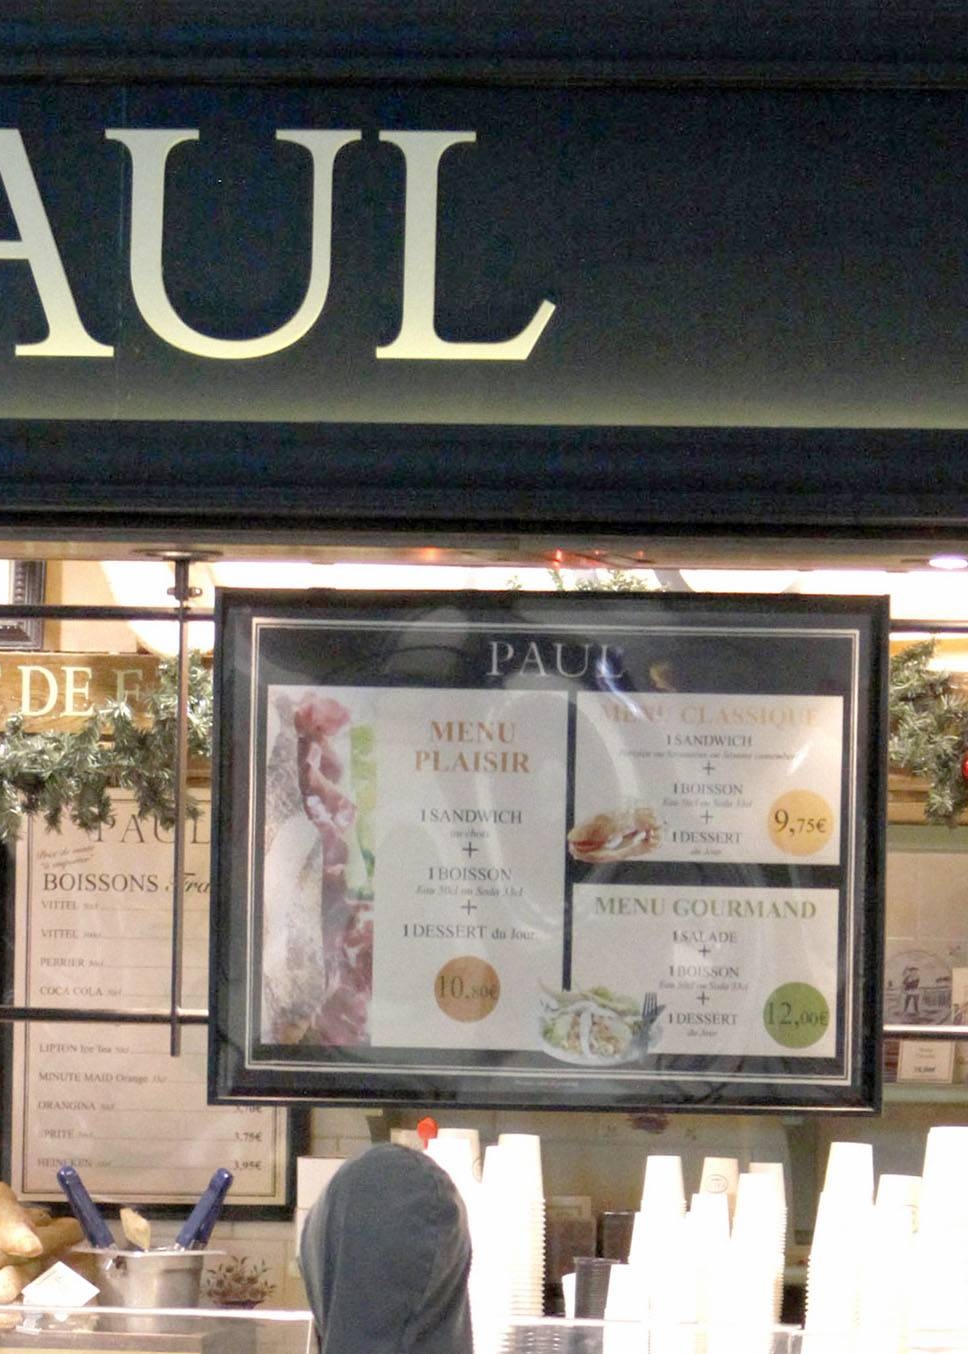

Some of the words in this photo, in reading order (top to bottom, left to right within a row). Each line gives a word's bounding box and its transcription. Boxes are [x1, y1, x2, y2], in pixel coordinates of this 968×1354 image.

[486, 641, 623, 679] PAUL
[17, 665, 95, 717] DE
[429, 721, 517, 743] MENU
[675, 735, 752, 747] SANDWICH
[415, 751, 531, 773] PLAISIR
[682, 783, 743, 795] BOISSON
[430, 809, 522, 824] SANDWICH
[774, 809, 827, 836] 9,75€
[680, 832, 743, 844] DESSERT
[438, 867, 512, 881] BOISSON
[44, 872, 159, 893] BOISSONS
[41, 899, 77, 910] VITTEL
[594, 897, 665, 917] MENU
[673, 899, 818, 919] GOURMAND
[41, 928, 78, 939] VITTEL
[413, 924, 487, 939] DESSERT
[680, 931, 738, 943] SALADE
[40, 957, 85, 967] PERRIER
[677, 965, 740, 978] BOISSON
[73, 986, 103, 996] COLA
[676, 1013, 738, 1025] DESSERT
[39, 1043, 78, 1053] LIPTON
[38, 1072, 81, 1081] MINUTE
[84, 1073, 114, 1082] MAID
[38, 1101, 95, 1111] ORANGINA
